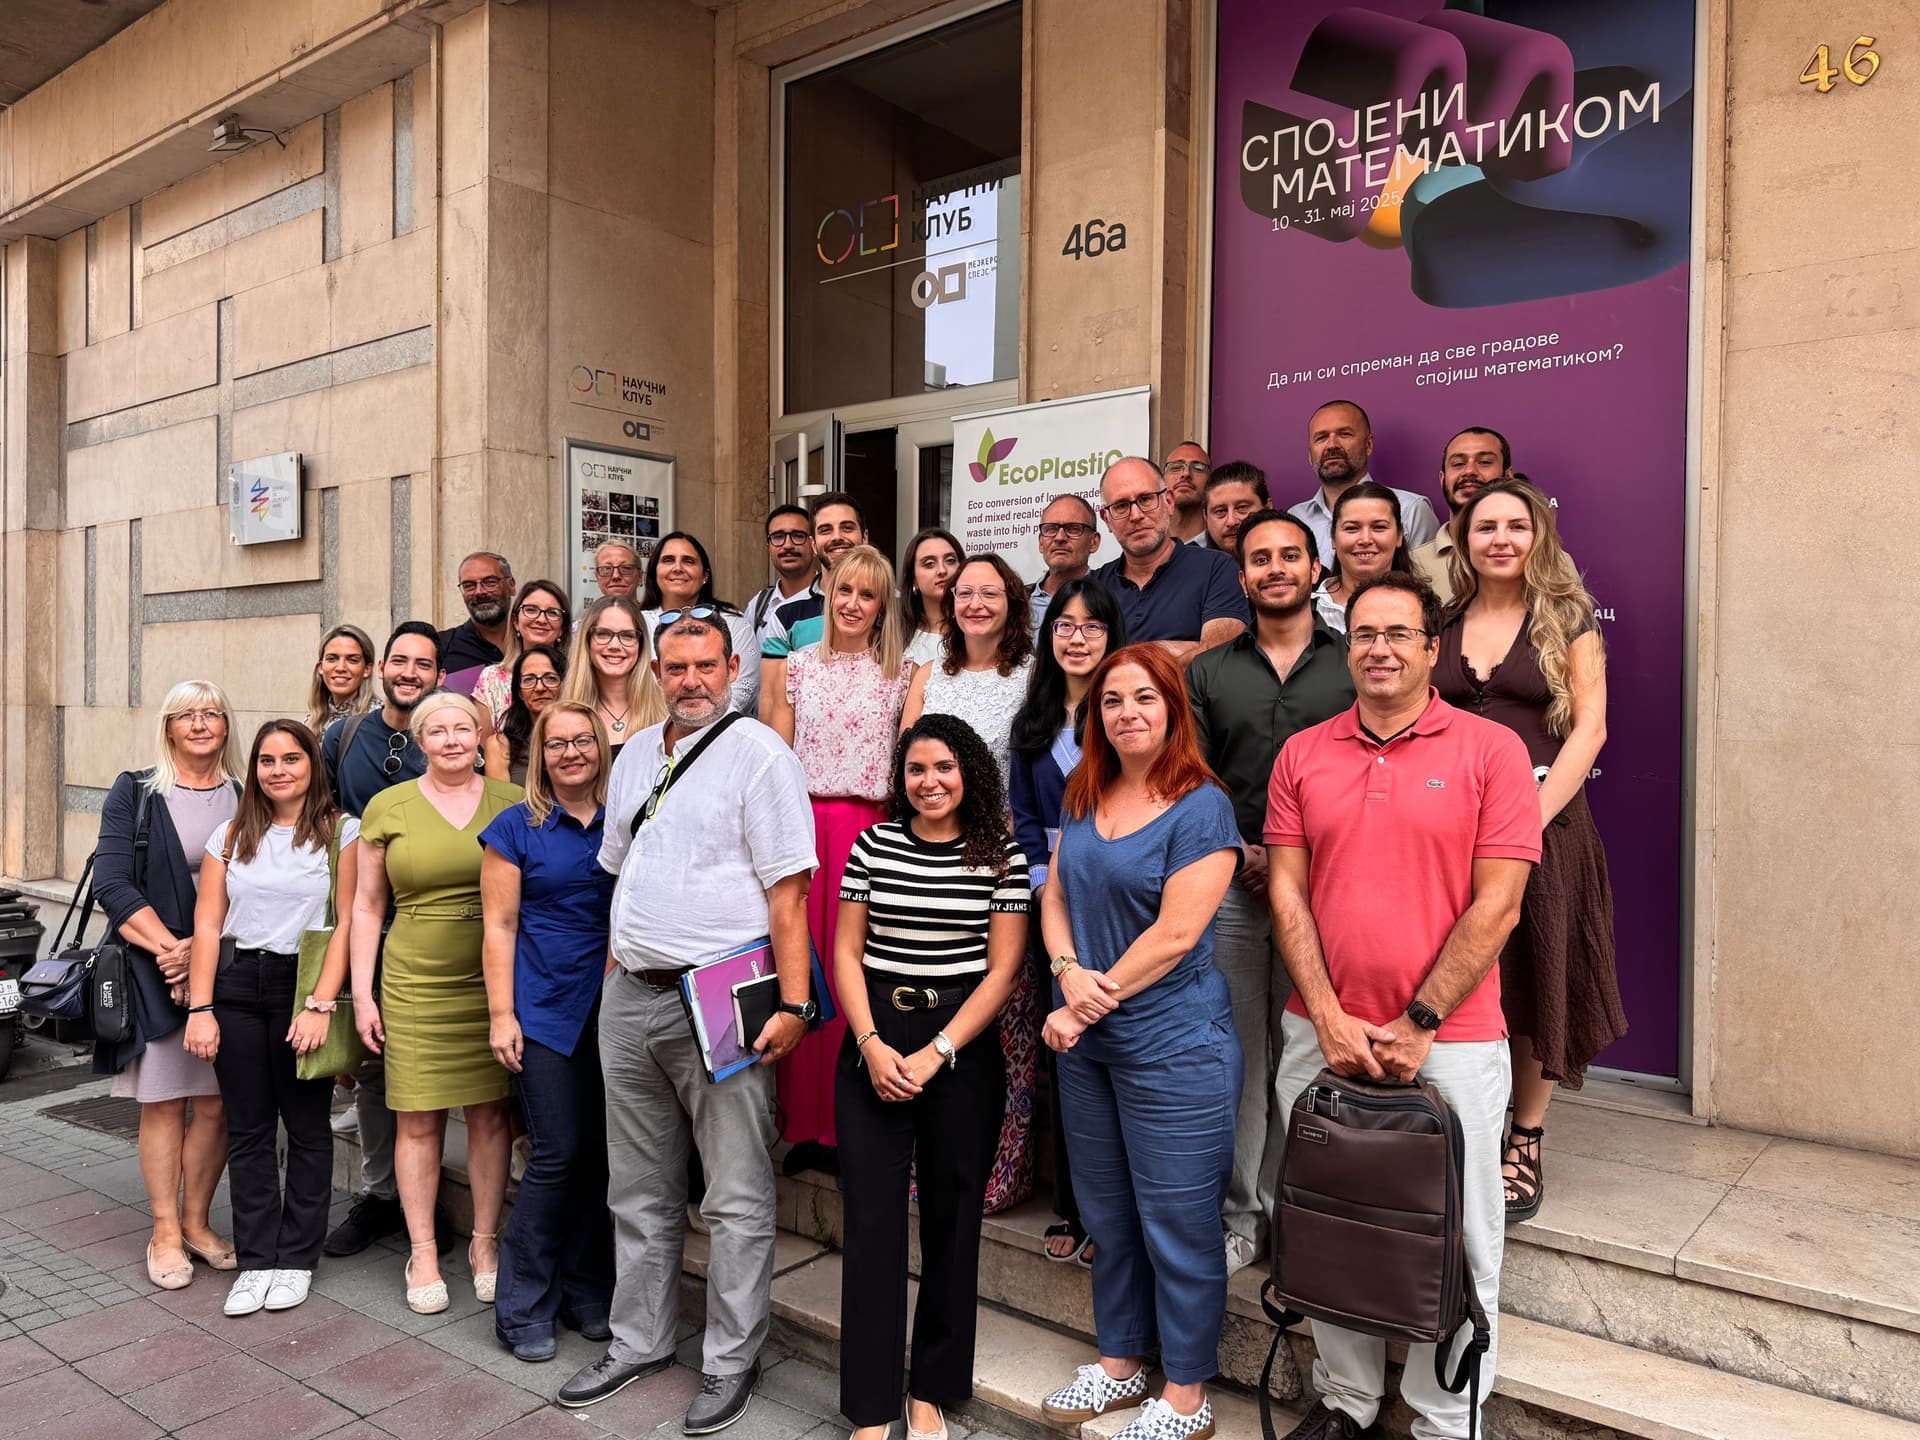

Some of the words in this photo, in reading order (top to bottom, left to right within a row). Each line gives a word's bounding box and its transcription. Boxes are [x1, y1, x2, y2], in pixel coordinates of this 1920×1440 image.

[1799, 34, 1881, 93] 46
[1242, 82, 1464, 172] СПОЈЕНИ
[1272, 82, 1660, 210] МАТЕМАТИКОМ
[912, 206, 972, 242] КЛУБ
[1271, 215, 1289, 232] 10
[1304, 209, 1325, 224] 31.
[1331, 202, 1355, 218] мај
[1360, 190, 1404, 212] 2025.
[1267, 372, 1288, 390] Да
[1293, 370, 1312, 384] ли
[1317, 366, 1336, 379] си
[1340, 354, 1413, 376] спреман
[1418, 350, 1440, 367] да
[1445, 344, 1476, 360] све
[1482, 332, 1560, 356] градове
[1415, 366, 1478, 386] спојиш
[1484, 343, 1624, 377] математиком?
[622, 375, 666, 396] НАУЧНИ
[622, 389, 653, 406] КЛУБ
[967, 500, 984, 510] Eco
[985, 494, 1033, 509] conversion
[1035, 492, 1045, 503] of
[966, 528, 992, 538] waste
[993, 526, 1010, 536] into
[1012, 523, 1031, 536] high
[967, 513, 983, 524] and
[984, 510, 1011, 522] mixed
[965, 540, 1019, 553] biopolymers
[1003, 902, 1028, 912] JEANS
